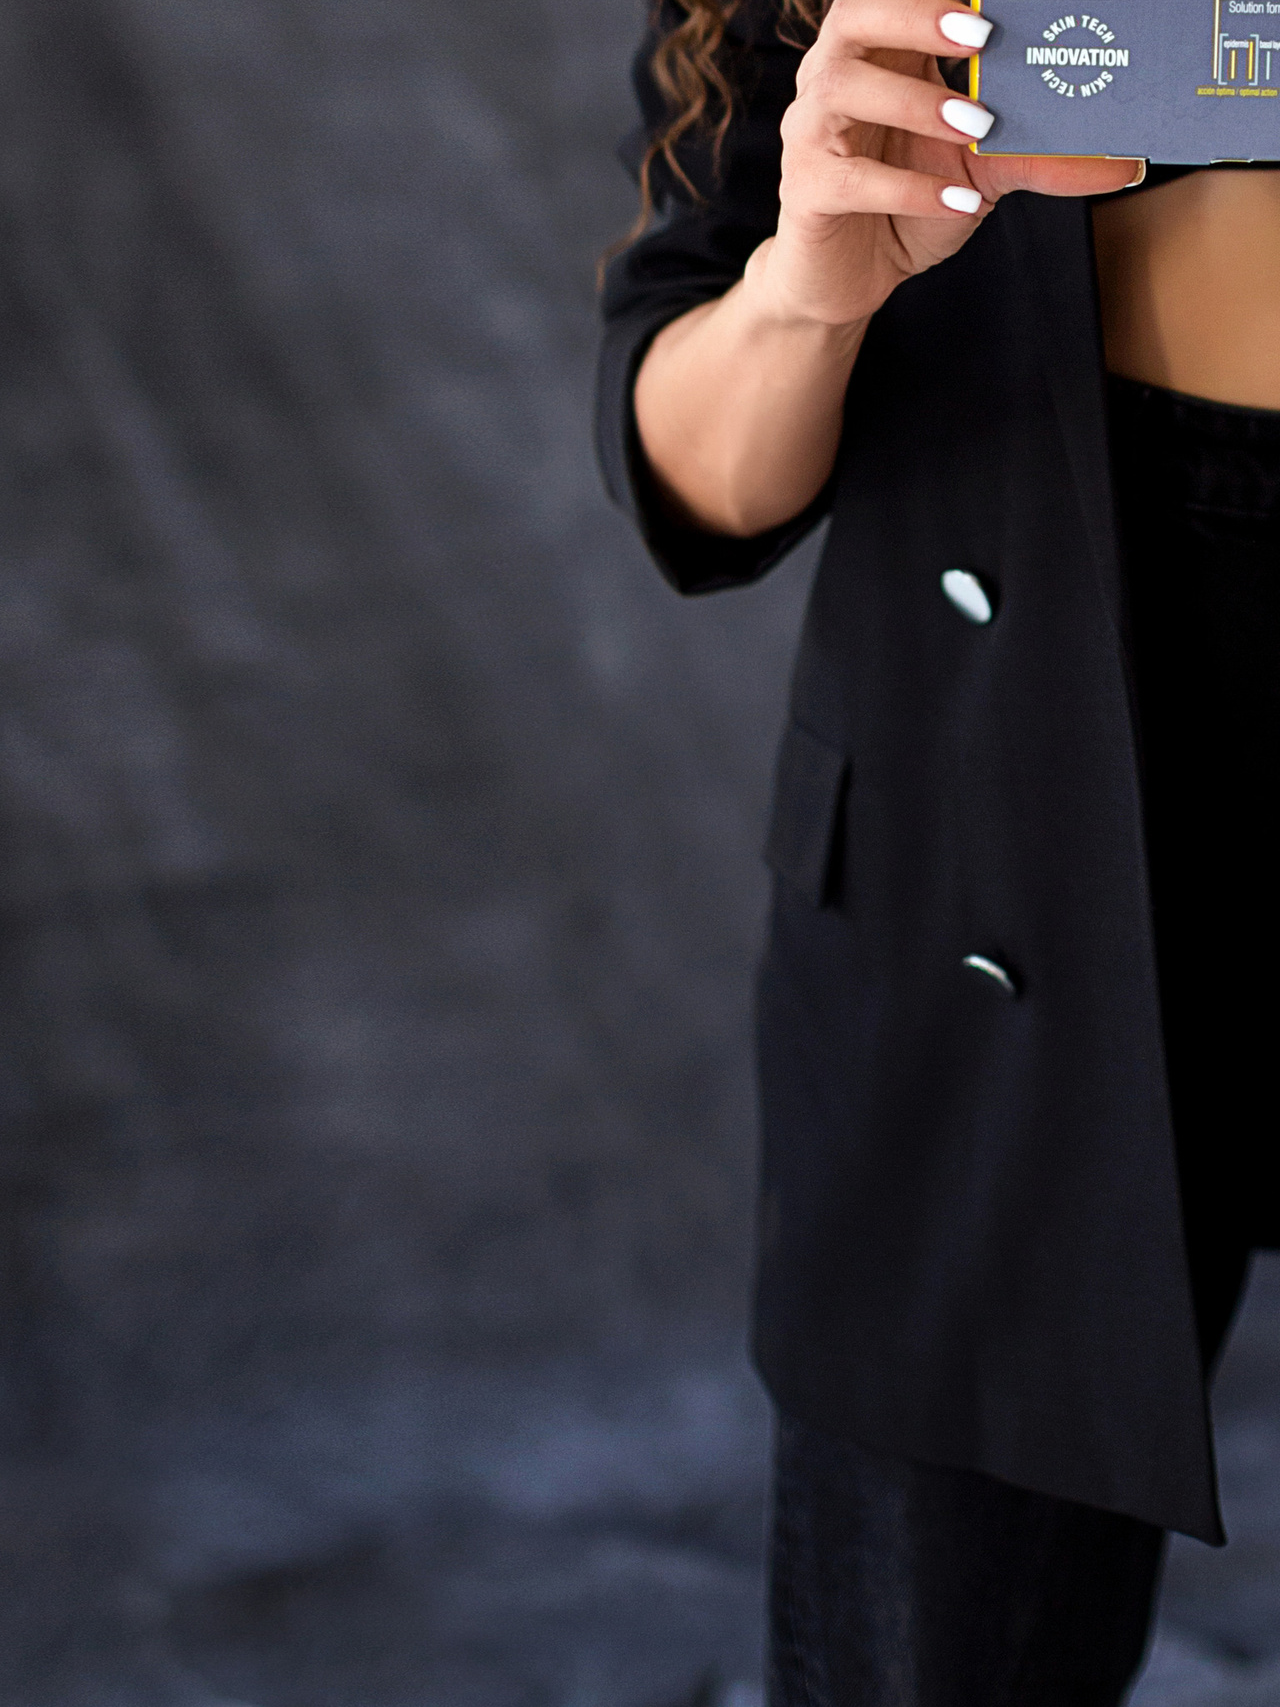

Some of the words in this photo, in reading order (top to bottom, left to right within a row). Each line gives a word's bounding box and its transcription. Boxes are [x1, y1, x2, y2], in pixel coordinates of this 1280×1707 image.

[1228, 0, 1264, 14] Solution
[1042, 14, 1076, 42] SKIN
[1081, 14, 1115, 44] TECH
[1026, 47, 1129, 67] INNOVATION
[1040, 68, 1075, 98] TECH
[1080, 70, 1114, 98] SKIN
